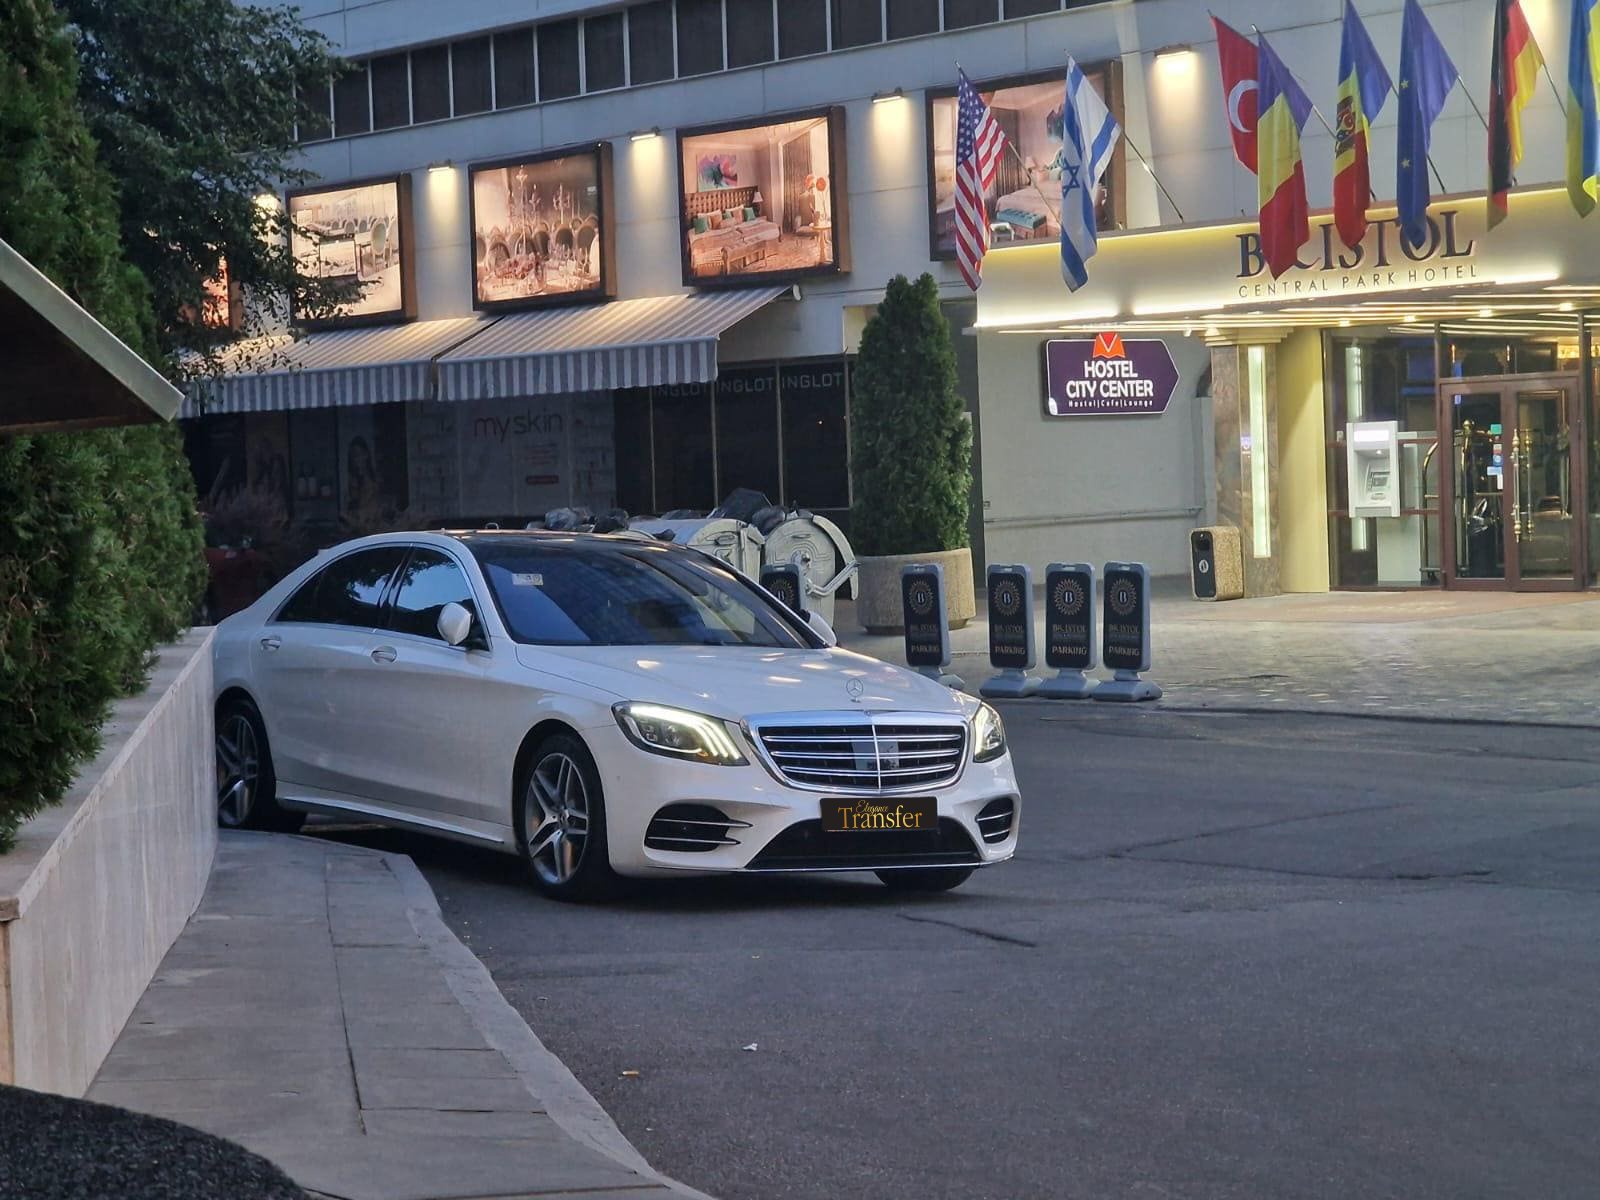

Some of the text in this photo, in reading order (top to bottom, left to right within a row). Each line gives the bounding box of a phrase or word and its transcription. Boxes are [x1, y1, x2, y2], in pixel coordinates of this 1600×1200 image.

[1238, 265, 1477, 298] CENTRAL PARK HOTEL
[1083, 360, 1139, 378] HOSTEL
[716, 376, 775, 393] INGLOT
[782, 372, 843, 389] INGLOT
[1065, 379, 1154, 398] CITY CENTER
[1052, 645, 1087, 656] PARKING
[1108, 646, 1140, 657] PARKING
